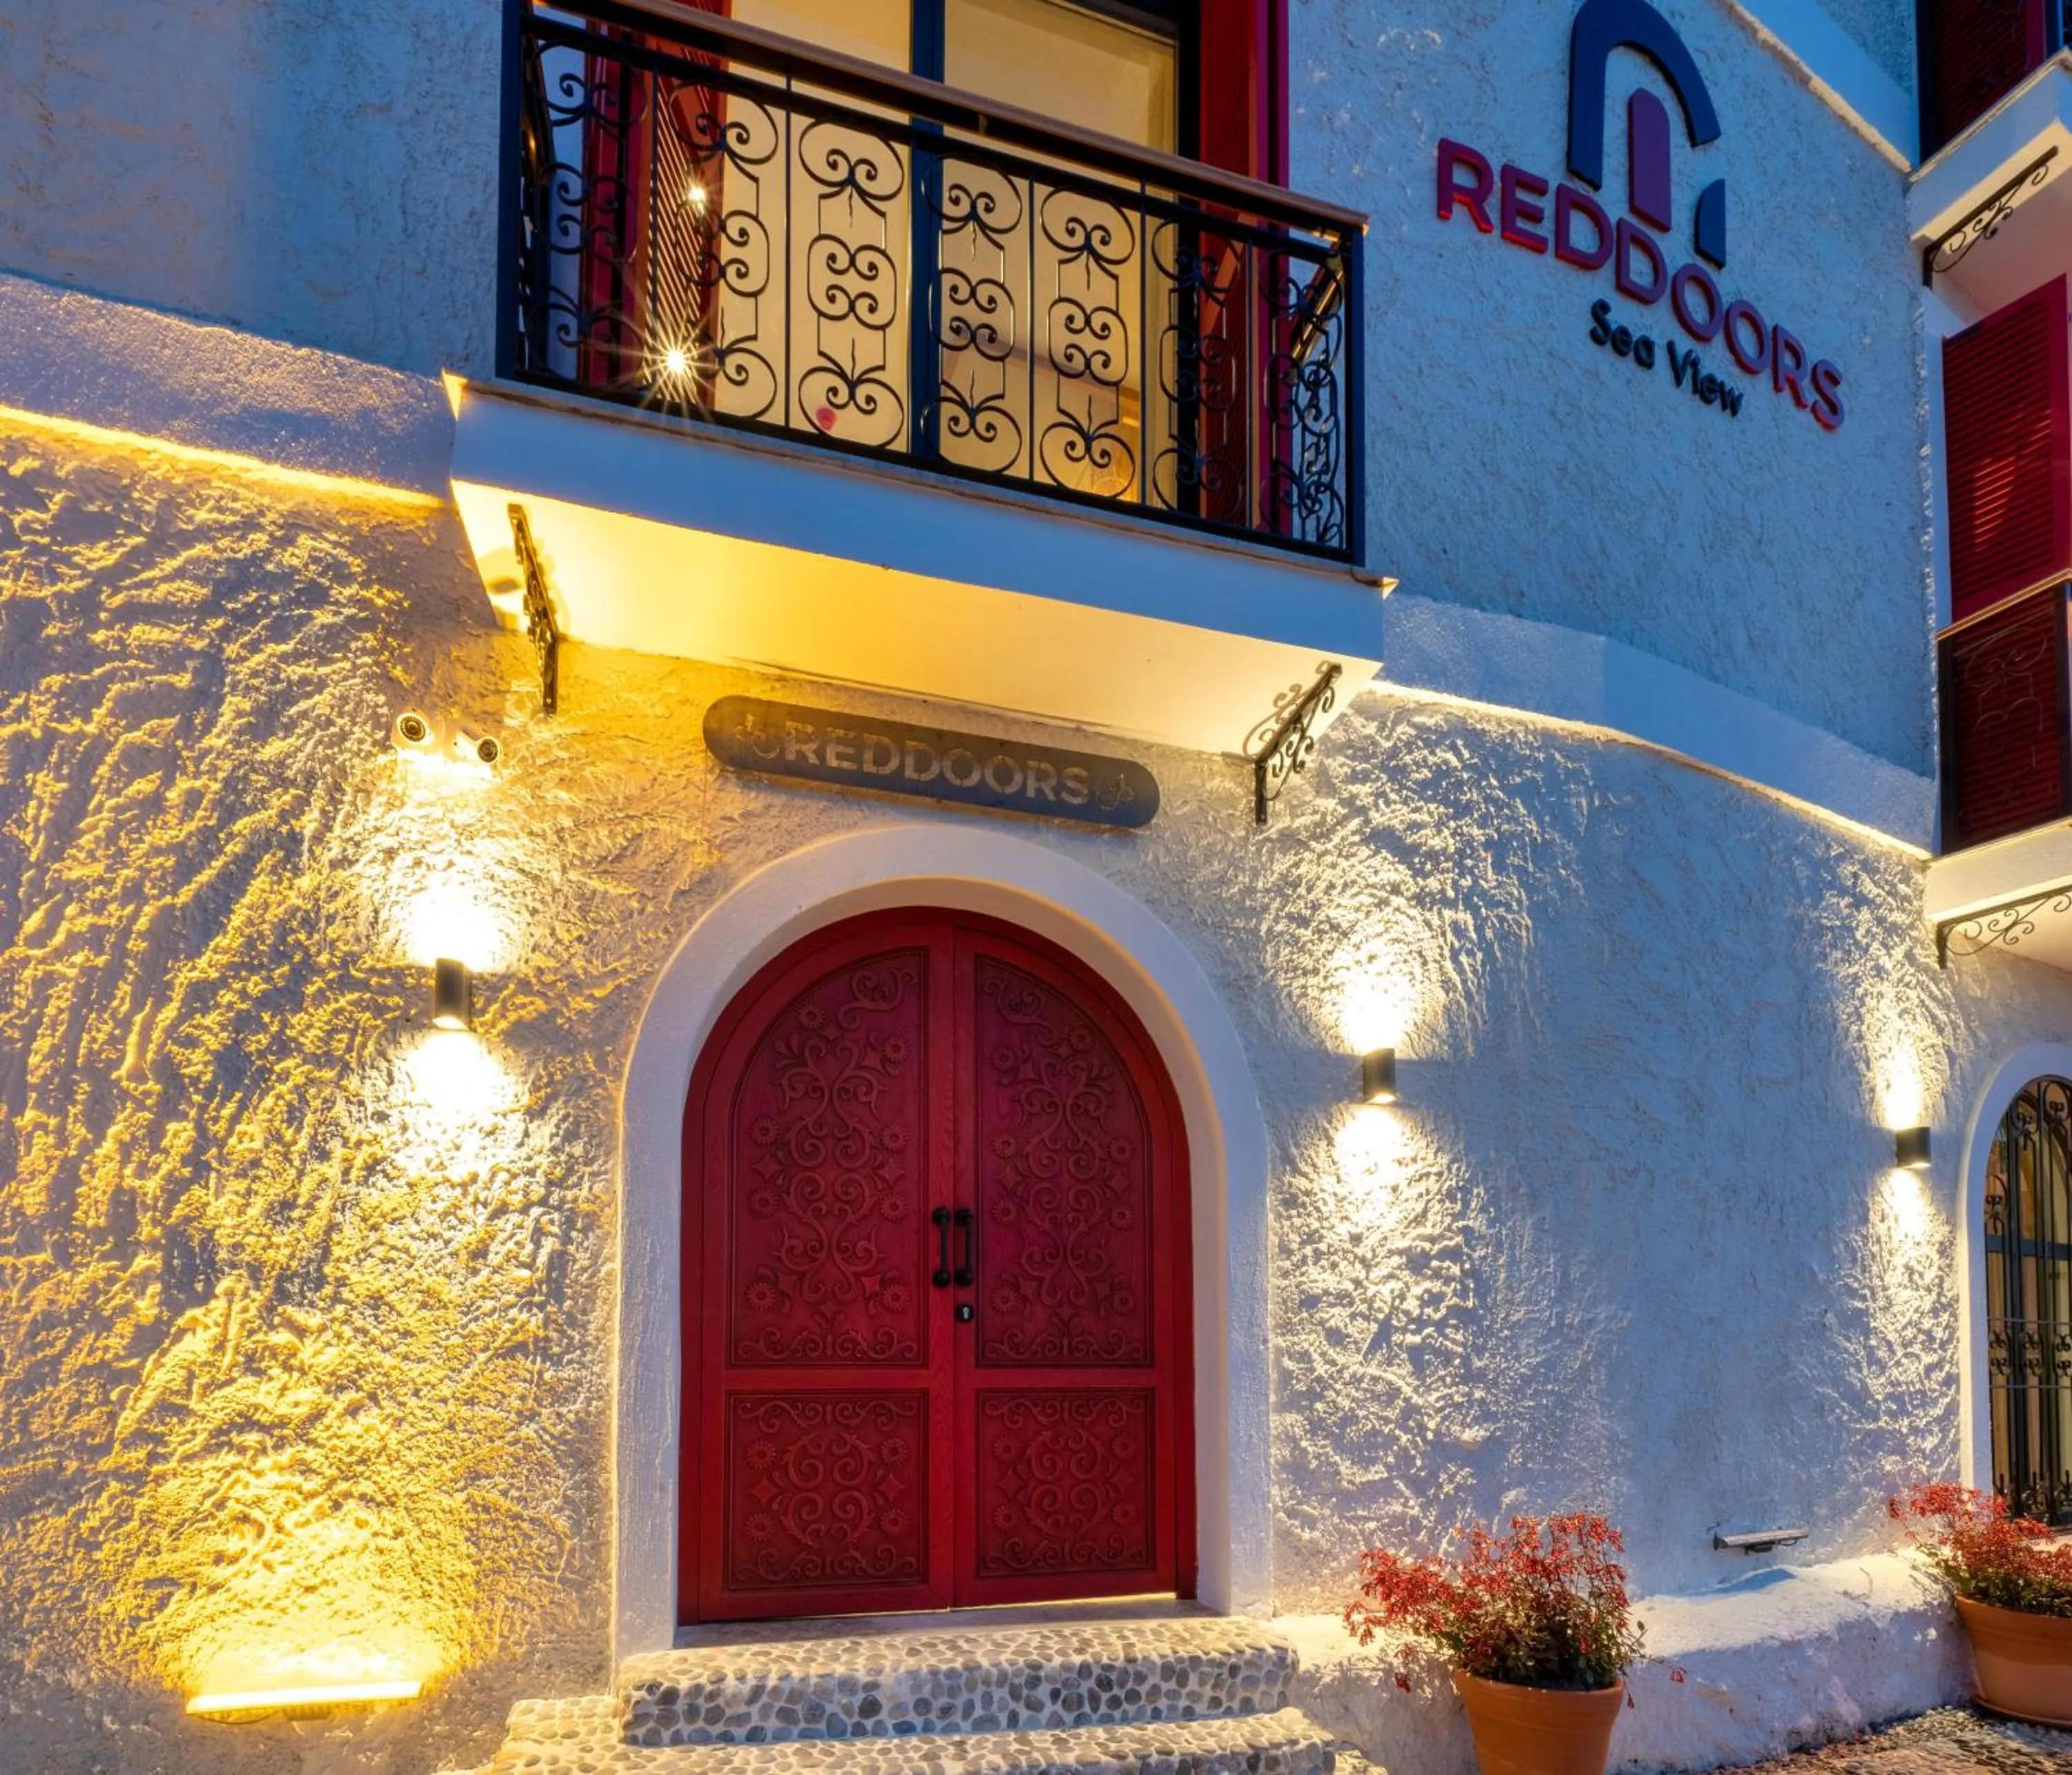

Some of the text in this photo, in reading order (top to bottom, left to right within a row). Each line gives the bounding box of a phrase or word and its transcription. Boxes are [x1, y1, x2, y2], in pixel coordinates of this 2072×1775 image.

[1437, 138, 1845, 431] REDDOORS
[1589, 299, 1744, 416] Sea View
[785, 721, 1089, 805] REDDOORS
